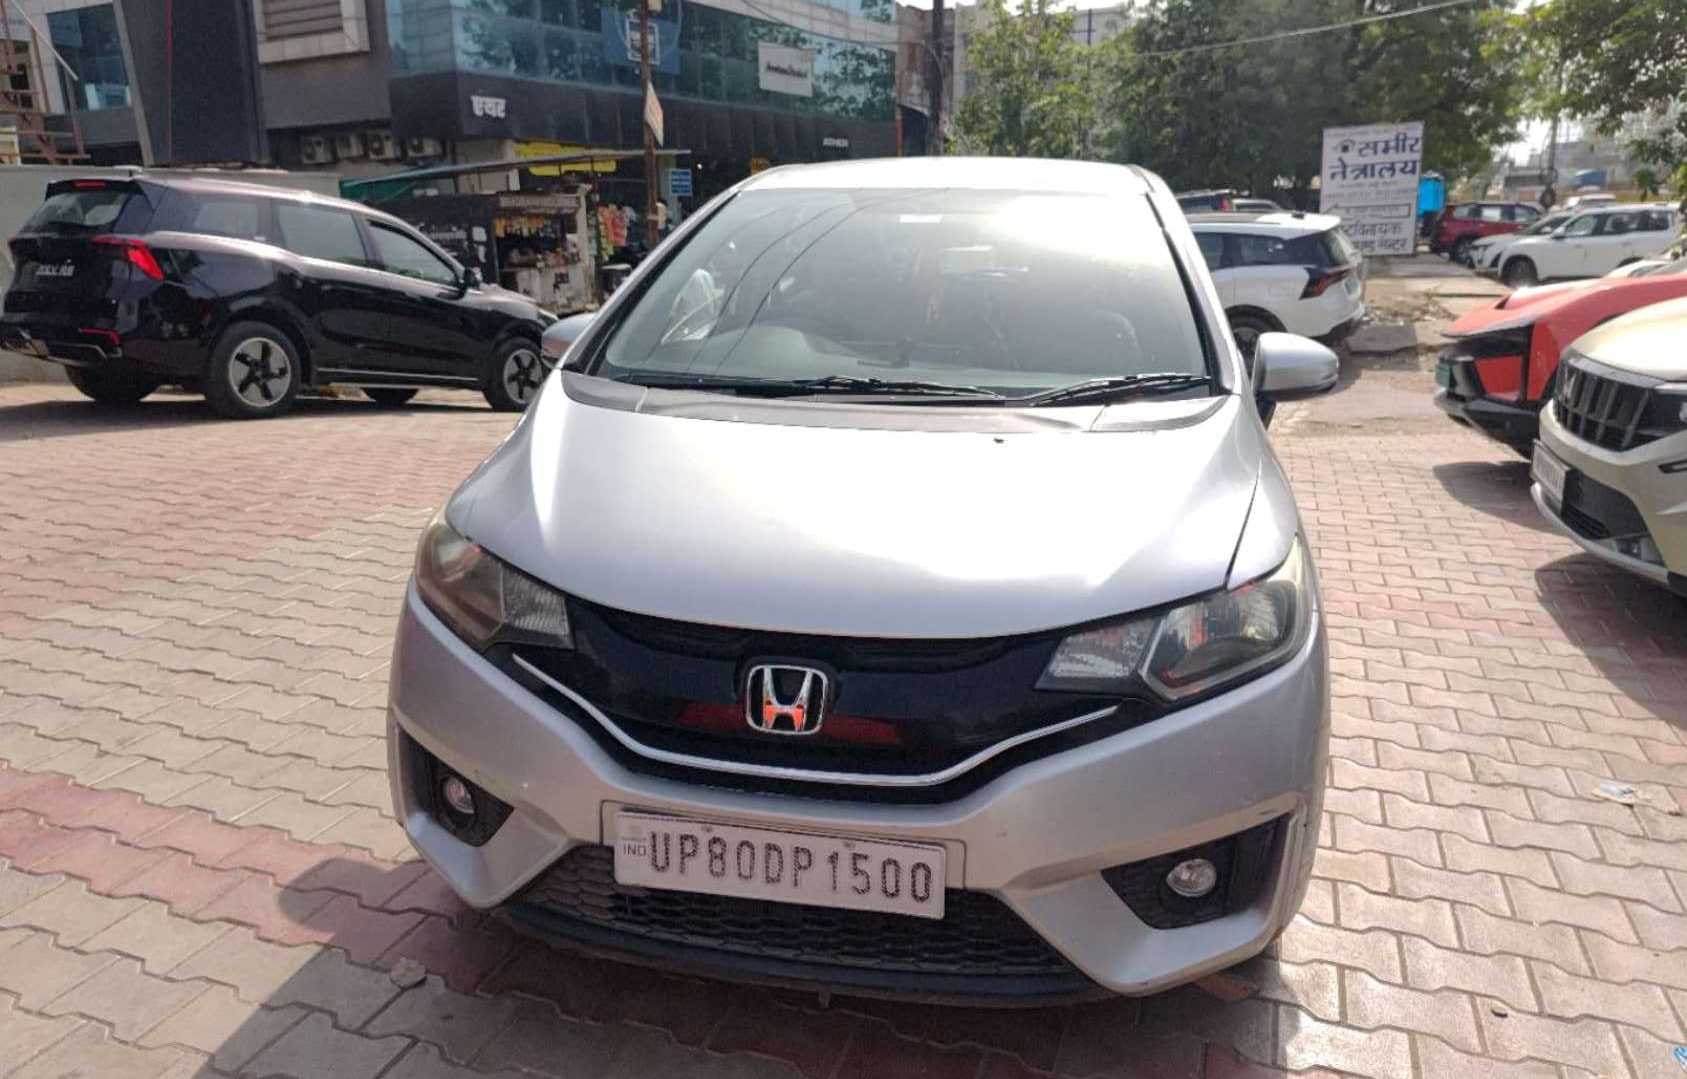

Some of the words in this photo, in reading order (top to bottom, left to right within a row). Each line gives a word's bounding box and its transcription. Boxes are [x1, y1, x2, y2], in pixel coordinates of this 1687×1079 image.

[1358, 132, 1420, 157] समीर
[1328, 157, 1418, 180] नेत्रालय
[623, 843, 647, 857] IND
[651, 831, 932, 902] UP80DP1500
